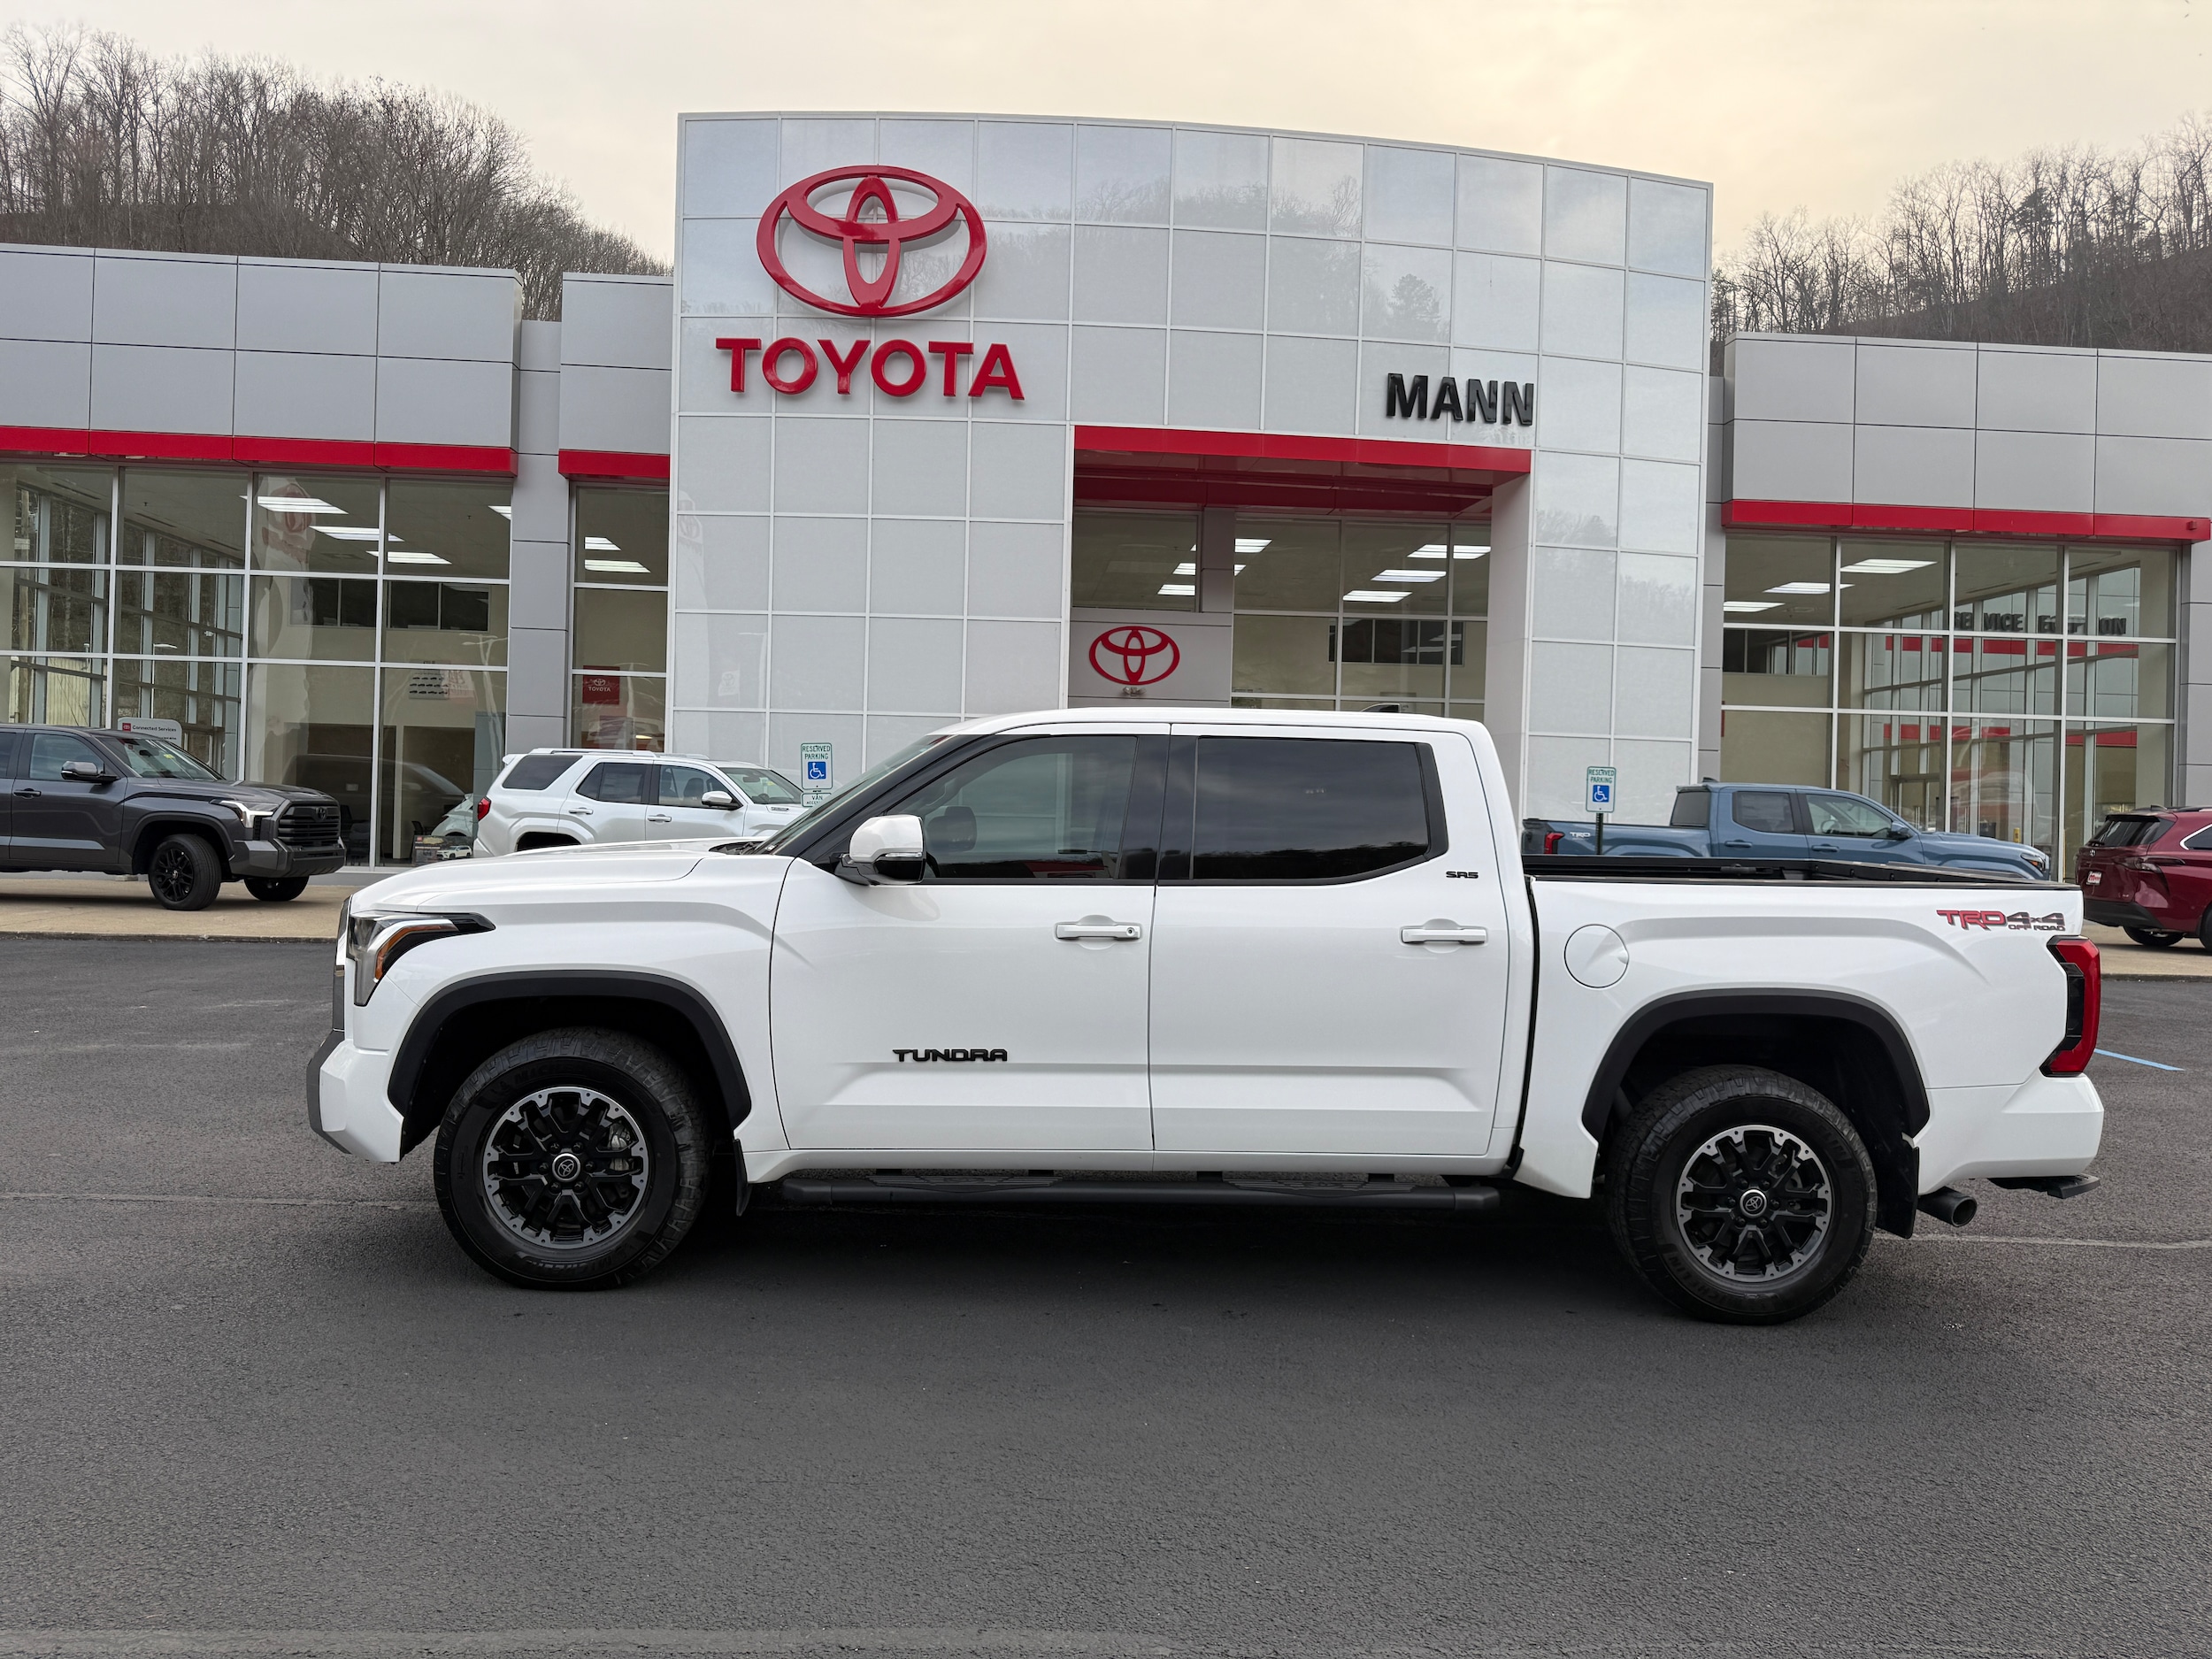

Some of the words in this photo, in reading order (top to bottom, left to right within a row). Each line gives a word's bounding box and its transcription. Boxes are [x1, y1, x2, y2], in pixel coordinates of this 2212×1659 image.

[716, 336, 1025, 401] TOYOTA
[1386, 373, 1534, 426] MANN
[1936, 910, 2008, 932] TRD
[892, 1048, 1008, 1062] TUNDRA
